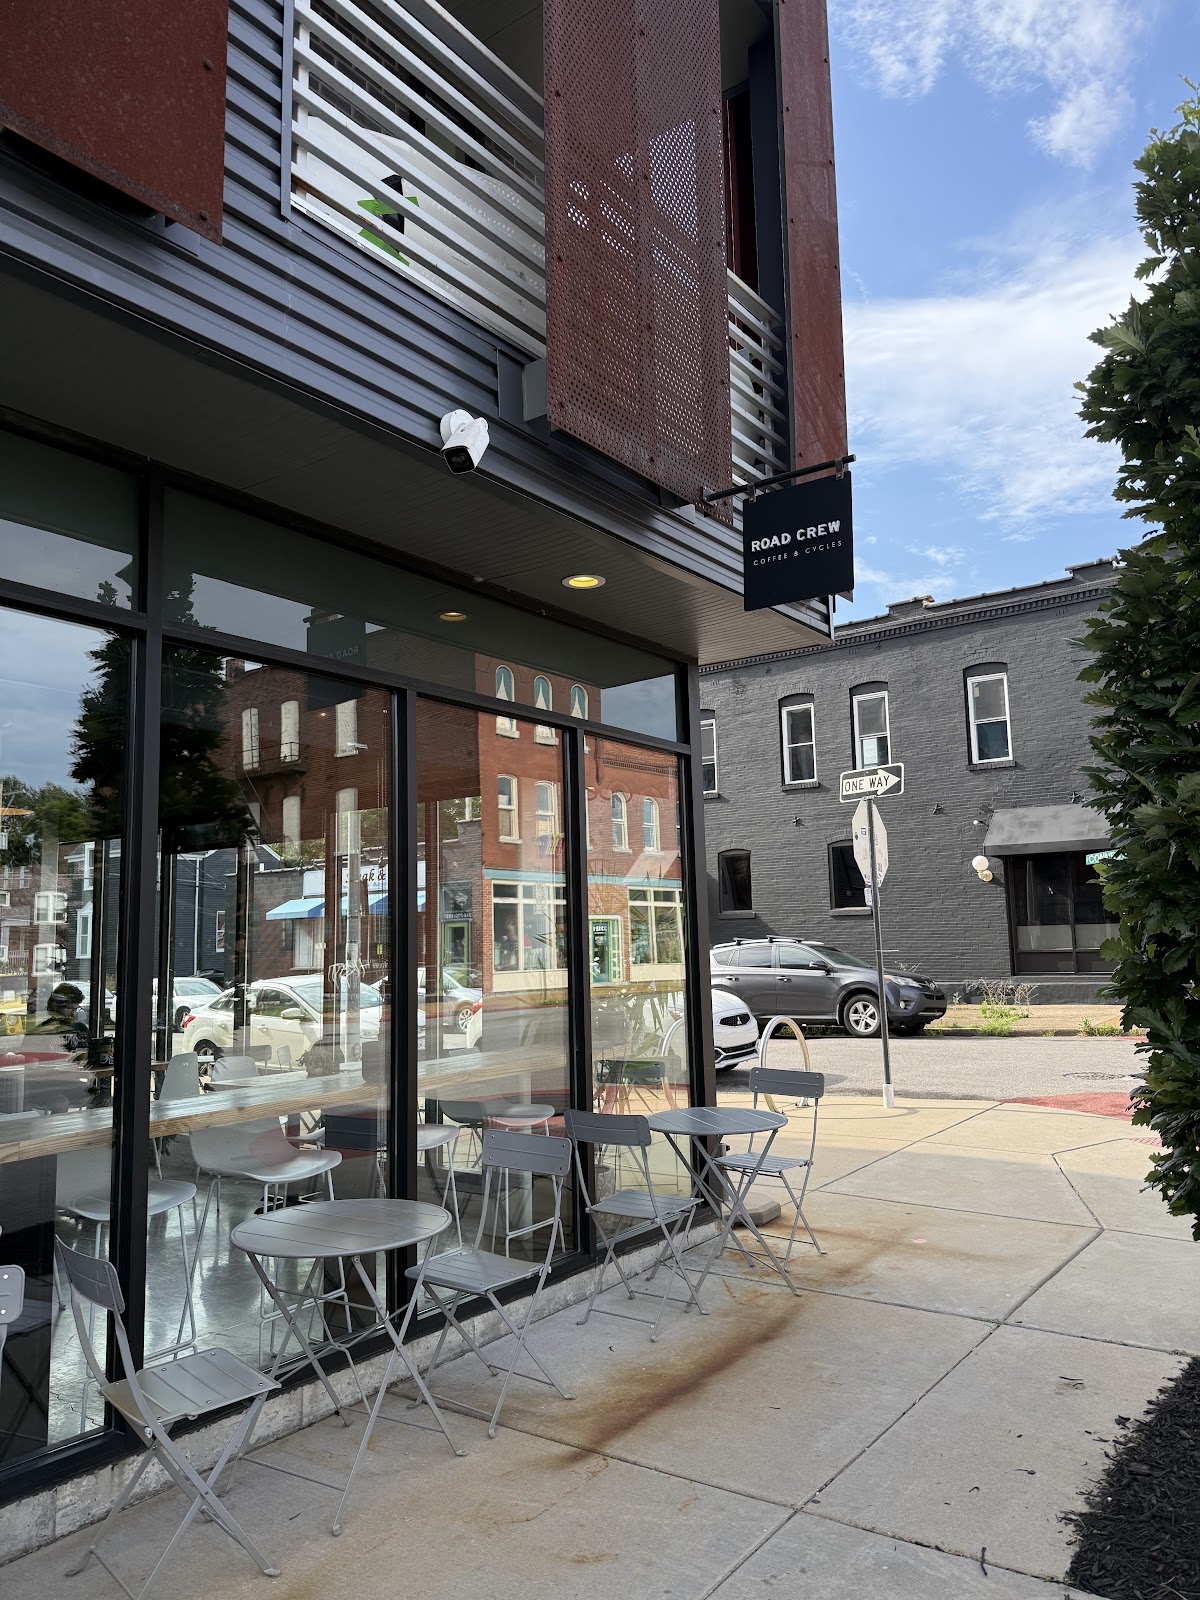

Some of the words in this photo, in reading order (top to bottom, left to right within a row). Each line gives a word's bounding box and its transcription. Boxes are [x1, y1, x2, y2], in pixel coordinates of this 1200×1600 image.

[751, 532, 791, 552] ROAD
[796, 520, 841, 541] CREW
[753, 553, 788, 566] COFFEE
[805, 540, 842, 554] CYCLES
[844, 778, 865, 793] ONE
[868, 775, 890, 789] WAY
